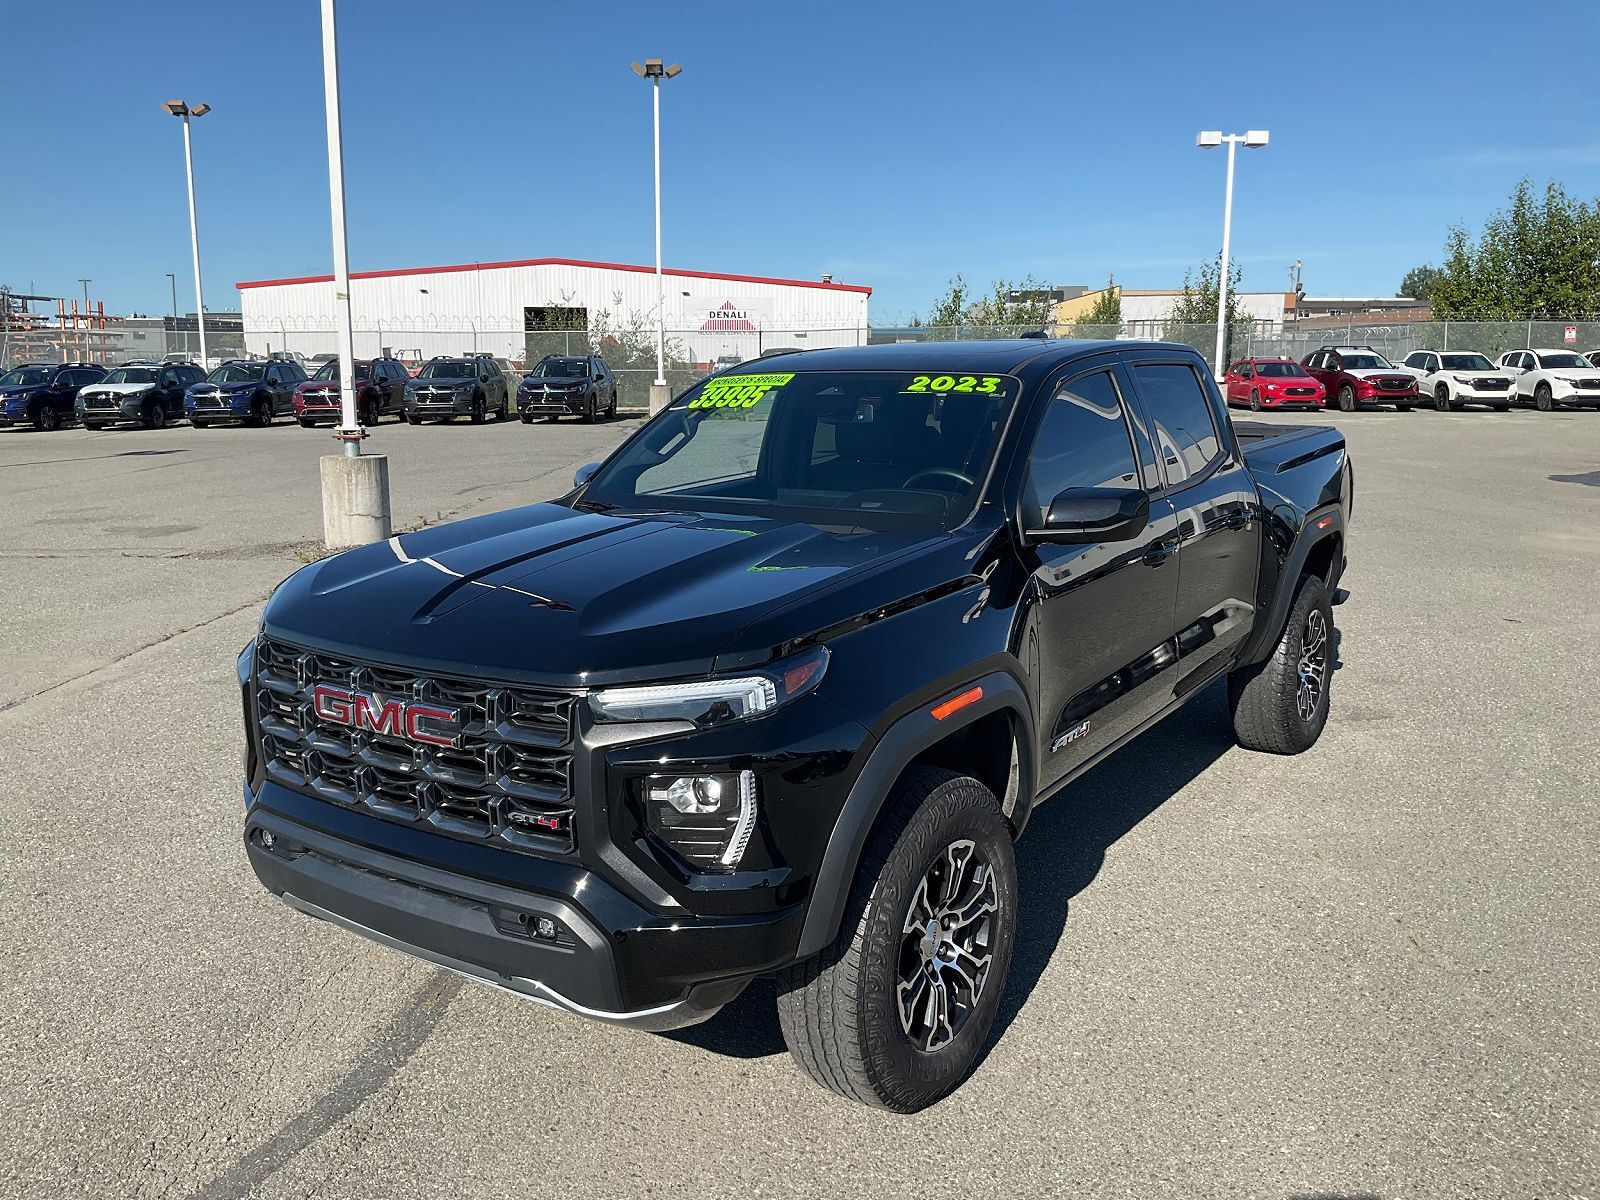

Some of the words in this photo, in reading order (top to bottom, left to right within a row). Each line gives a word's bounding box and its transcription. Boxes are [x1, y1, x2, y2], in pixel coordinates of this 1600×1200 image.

[709, 311, 747, 319] DENALI
[755, 375, 788, 384] SPECIAL
[907, 376, 1001, 393] 2023
[688, 386, 772, 409] 39995
[313, 683, 461, 749] GMC
